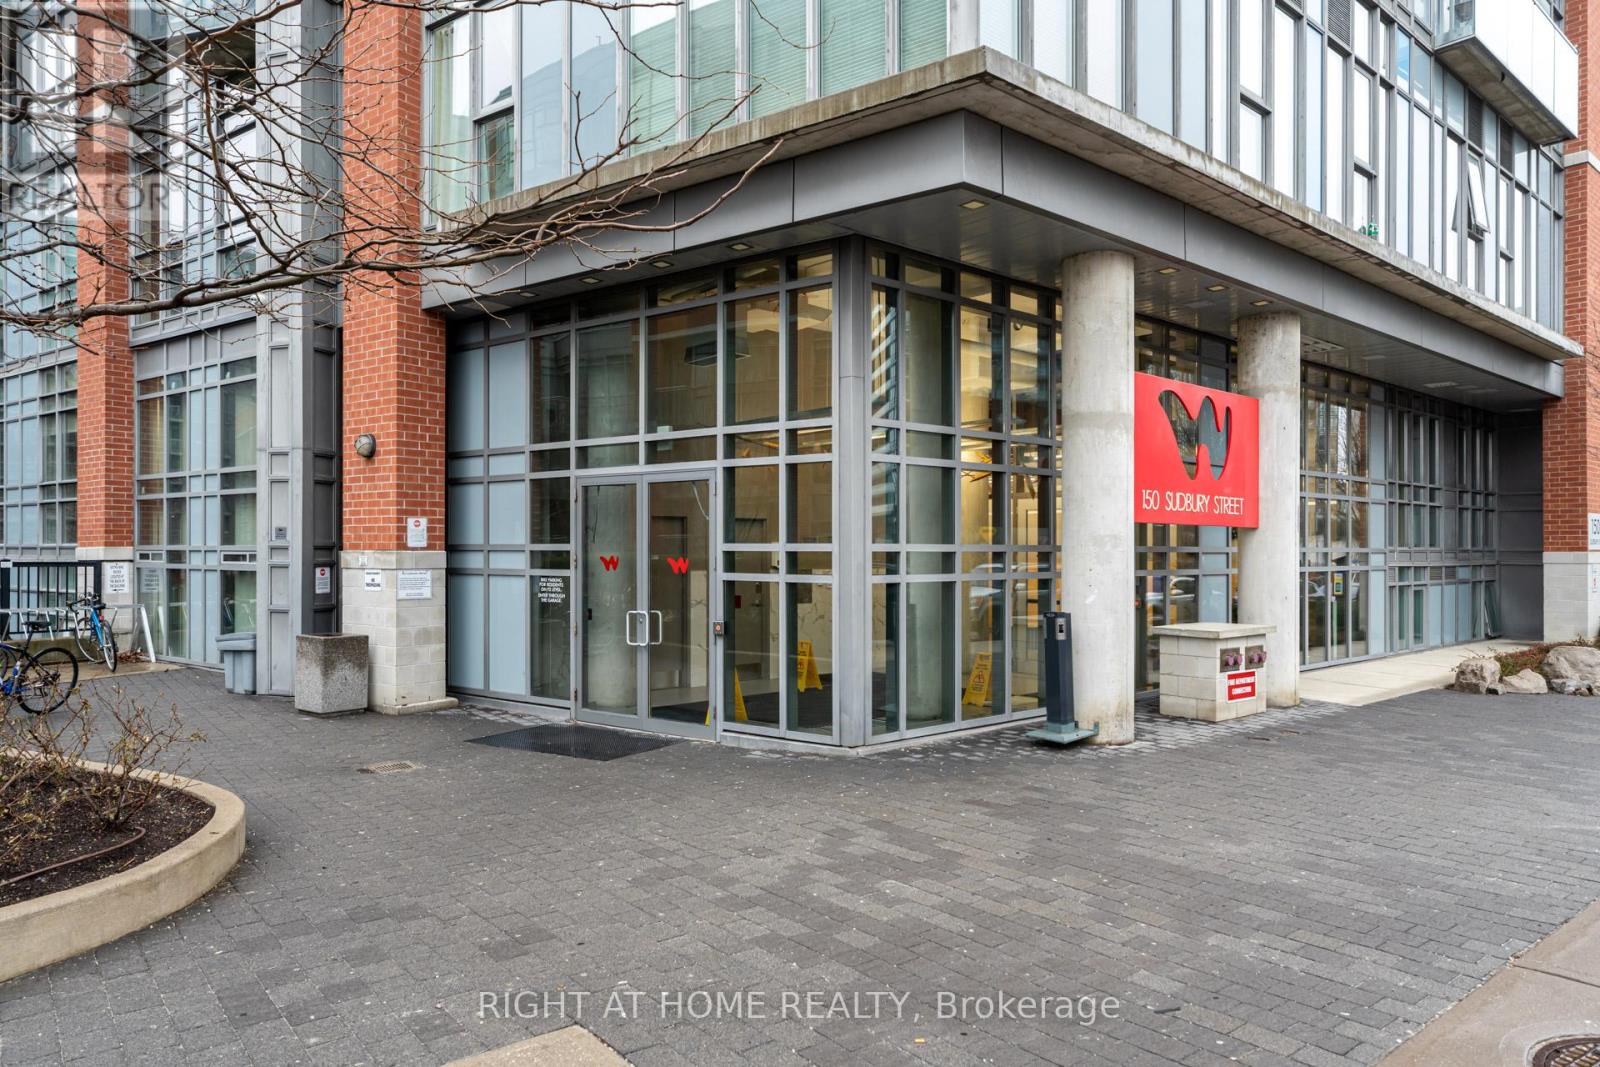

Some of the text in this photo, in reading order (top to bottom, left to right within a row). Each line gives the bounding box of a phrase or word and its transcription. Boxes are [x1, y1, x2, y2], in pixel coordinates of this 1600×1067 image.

[1141, 489, 1245, 515] 150 SUDBURY STREET
